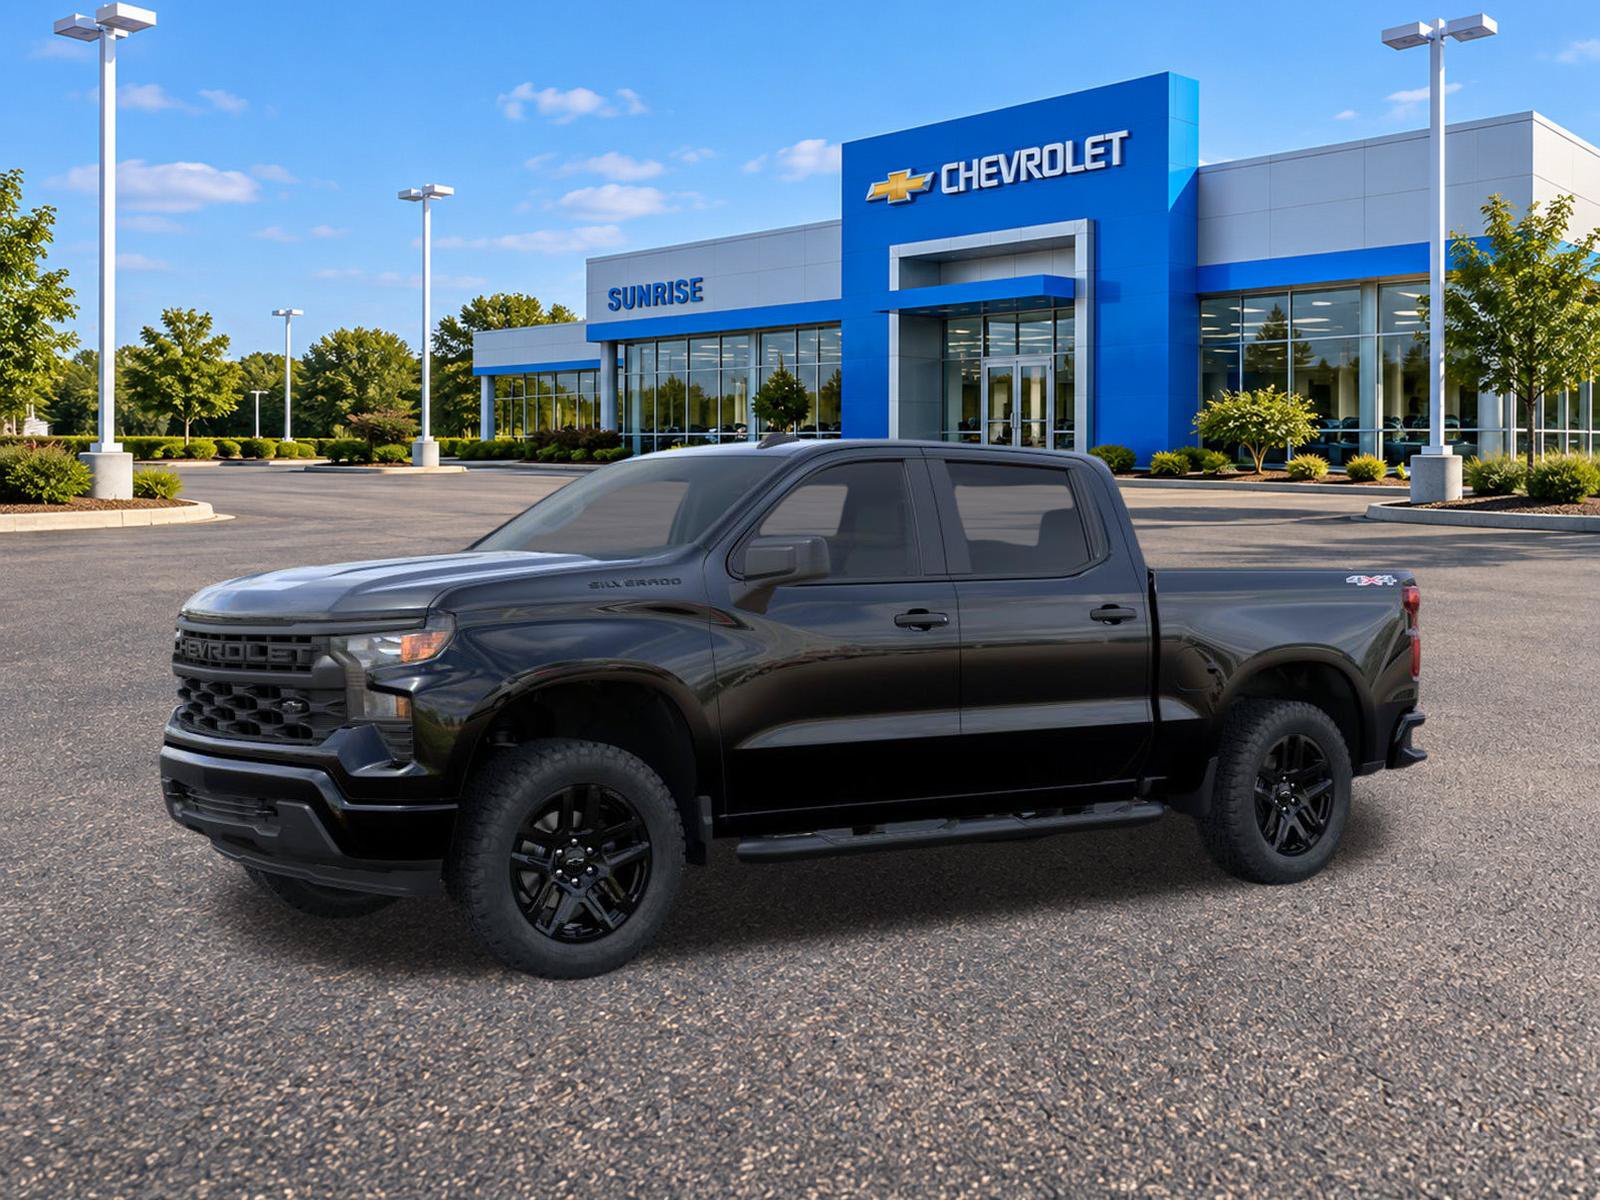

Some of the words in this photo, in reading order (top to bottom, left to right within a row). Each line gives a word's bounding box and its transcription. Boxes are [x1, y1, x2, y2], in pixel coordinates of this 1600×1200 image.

[941, 130, 1129, 194] CHEVROLET
[608, 277, 704, 312] SUNRISE
[588, 578, 682, 589] SILVERADO
